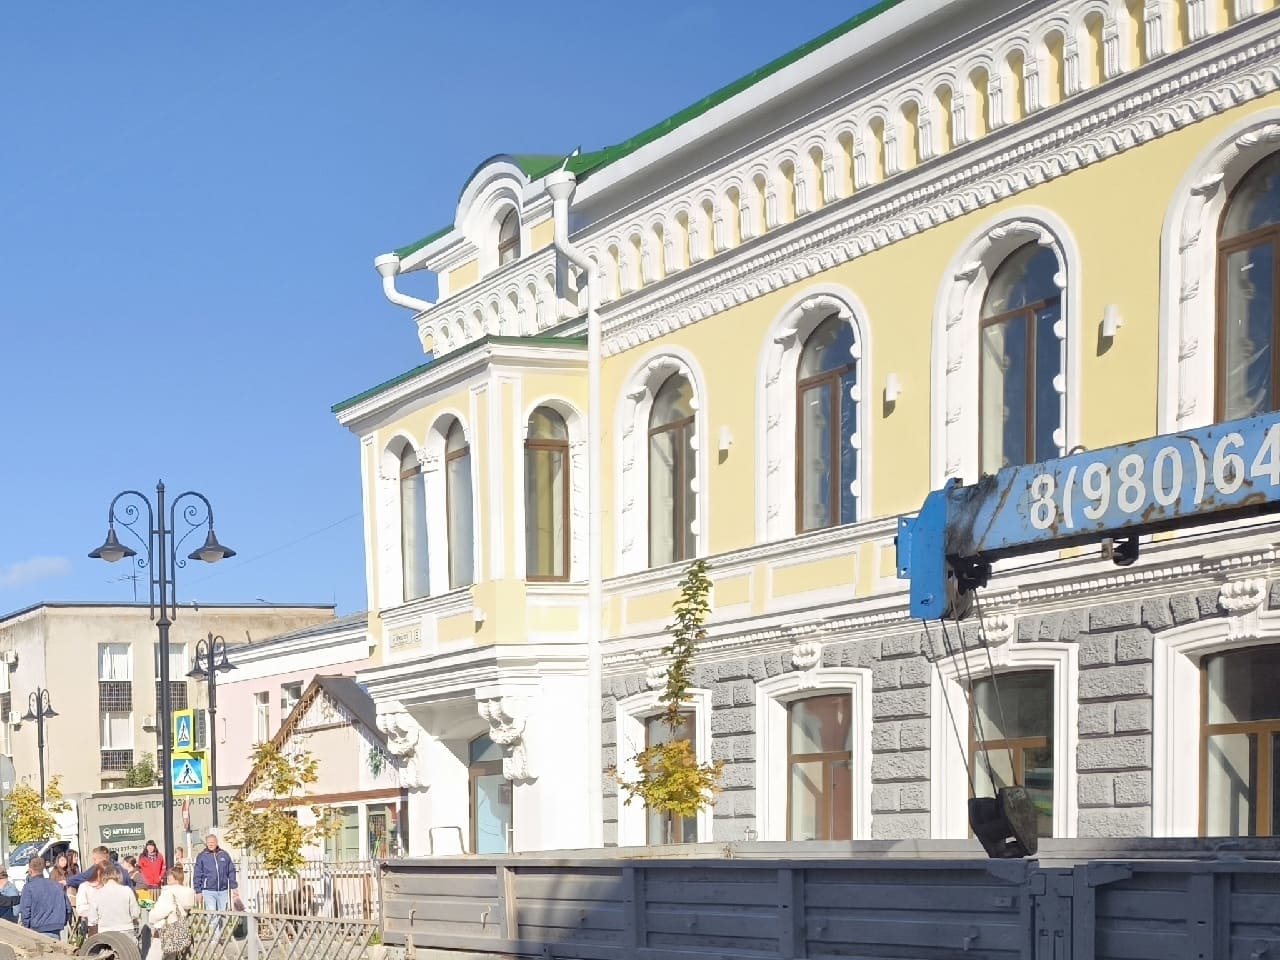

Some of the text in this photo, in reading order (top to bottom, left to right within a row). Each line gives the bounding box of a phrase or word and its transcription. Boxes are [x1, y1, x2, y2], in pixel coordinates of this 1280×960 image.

[1029, 422, 1280, 530] 8(980)64
[97, 801, 144, 812] ГРУЗОВЫЕ
[145, 797, 195, 809] ПЕРОЗИ
[198, 797, 211, 805] ПО
